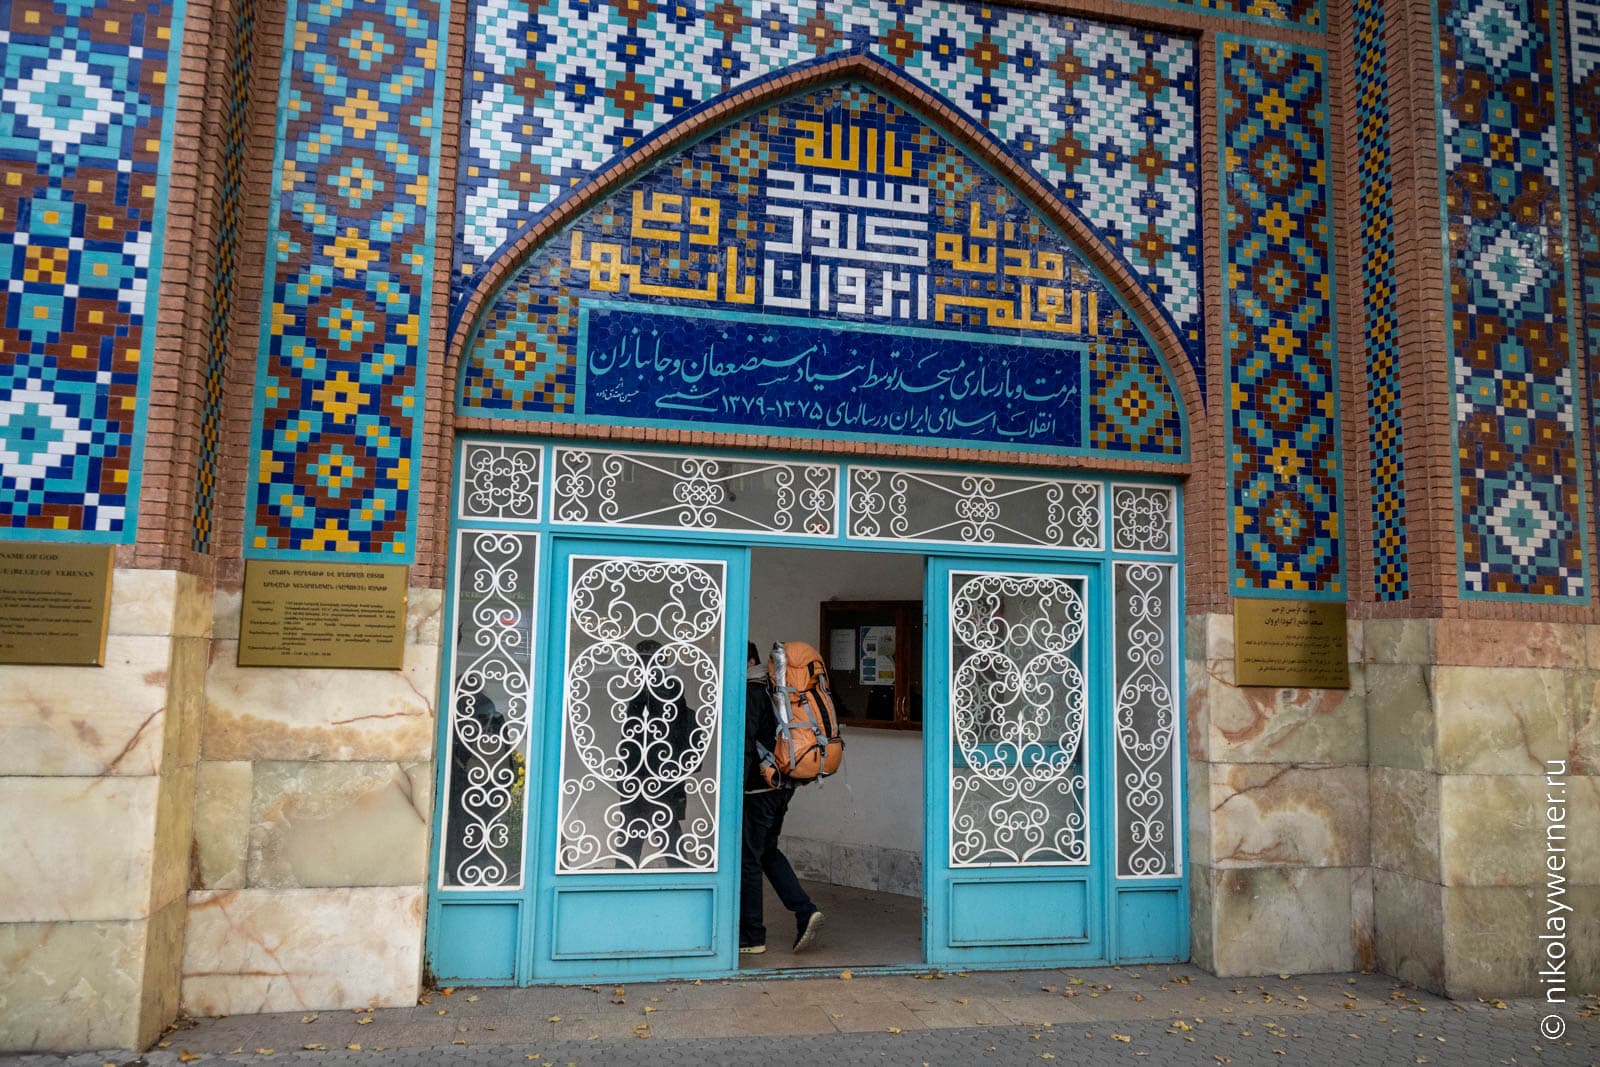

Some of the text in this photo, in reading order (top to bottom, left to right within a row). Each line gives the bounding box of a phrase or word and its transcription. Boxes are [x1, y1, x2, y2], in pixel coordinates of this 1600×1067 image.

[859, 350, 899, 390] توسط
[895, 352, 966, 400] مسجد
[889, 405, 928, 433] ایران
[928, 407, 996, 435] اسلامی
[997, 410, 1056, 442] انقلاب
